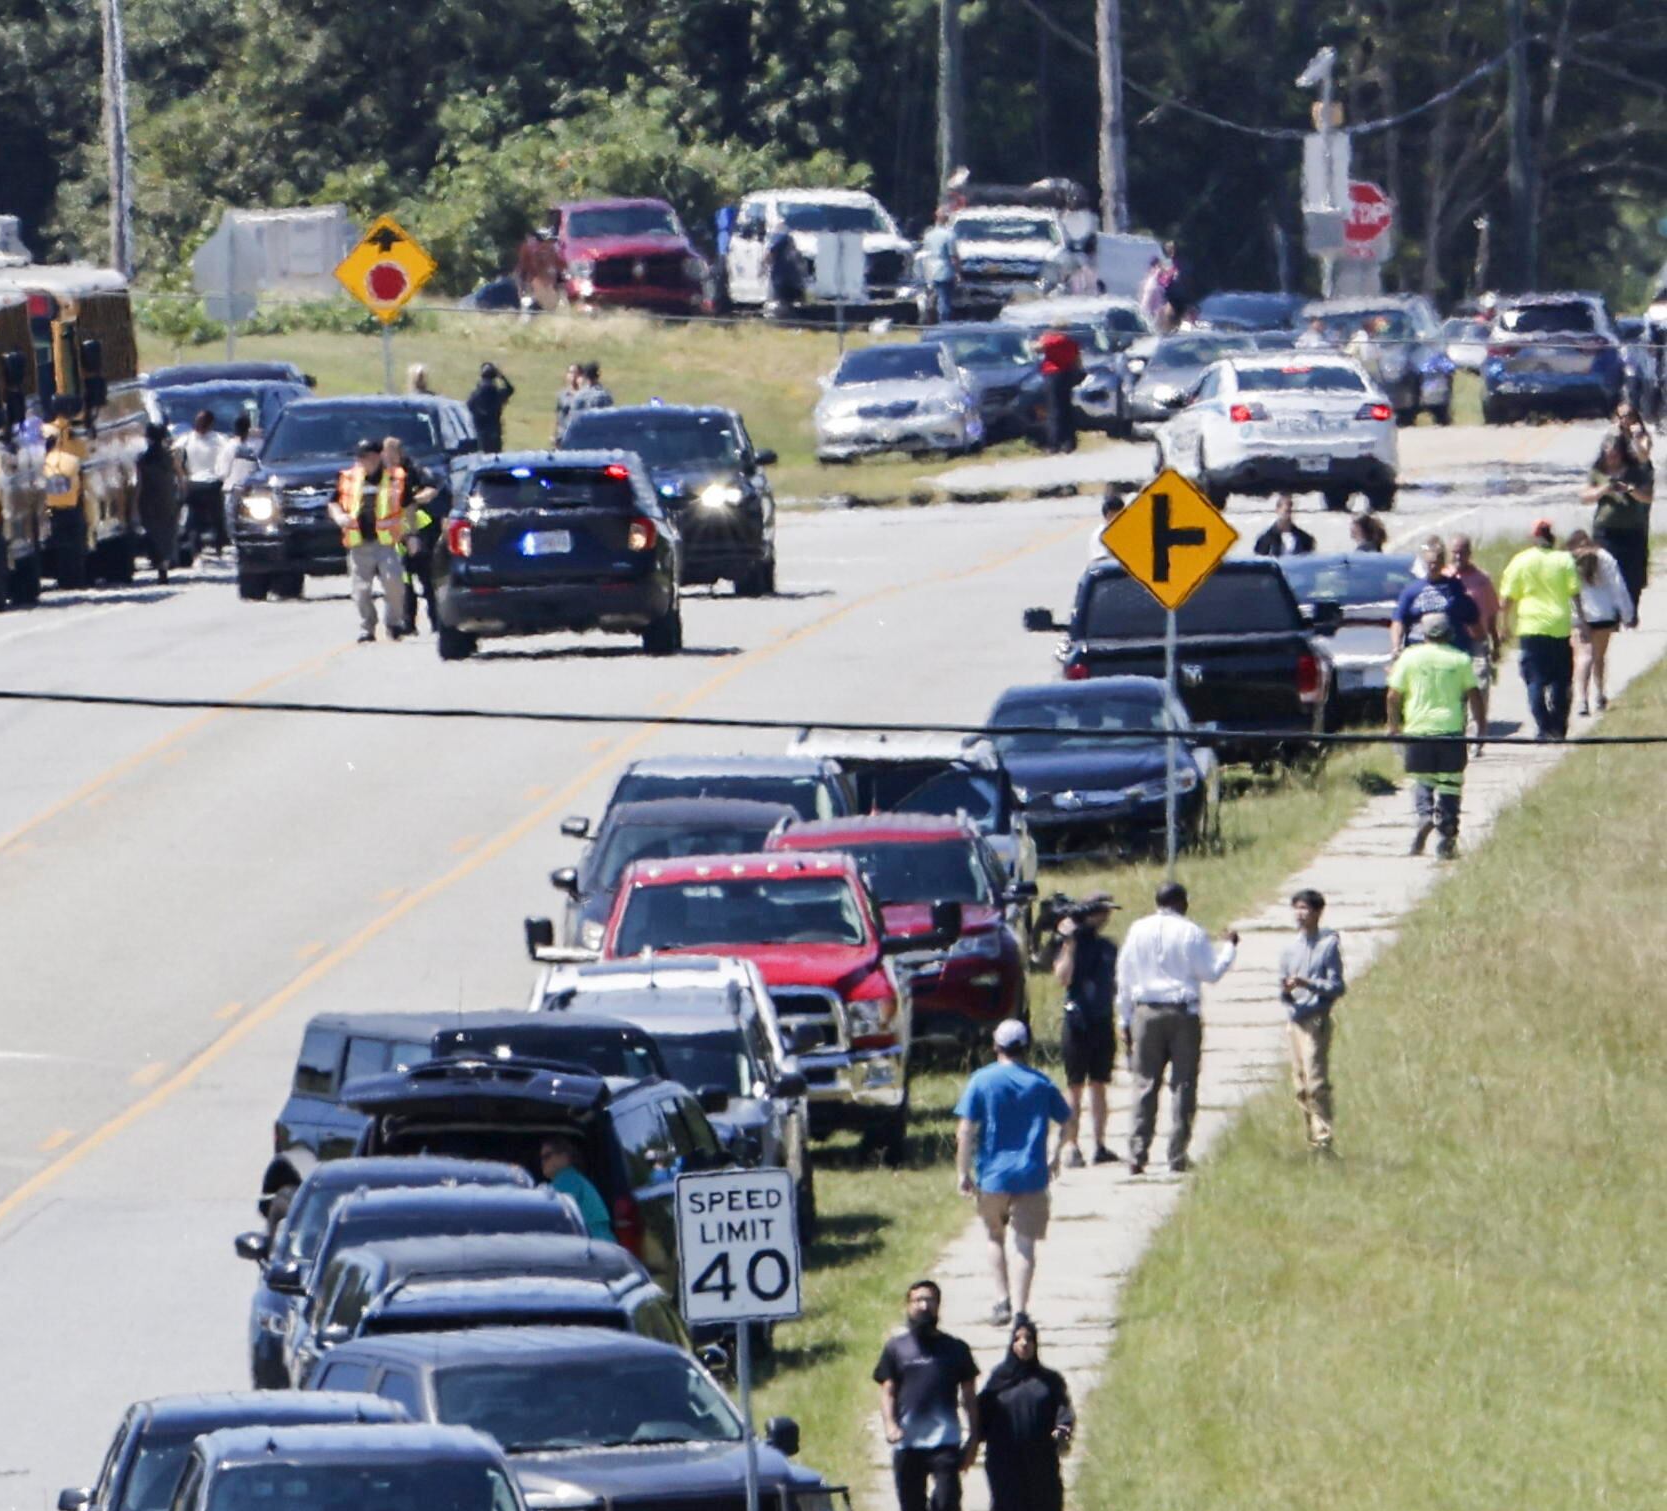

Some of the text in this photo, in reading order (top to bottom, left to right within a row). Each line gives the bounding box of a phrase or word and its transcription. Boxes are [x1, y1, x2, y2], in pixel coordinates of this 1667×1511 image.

[1346, 202, 1385, 224] TOP
[688, 1188, 782, 1214] SPEED
[700, 1218, 774, 1244] LIMIT
[691, 1248, 790, 1302] 40
